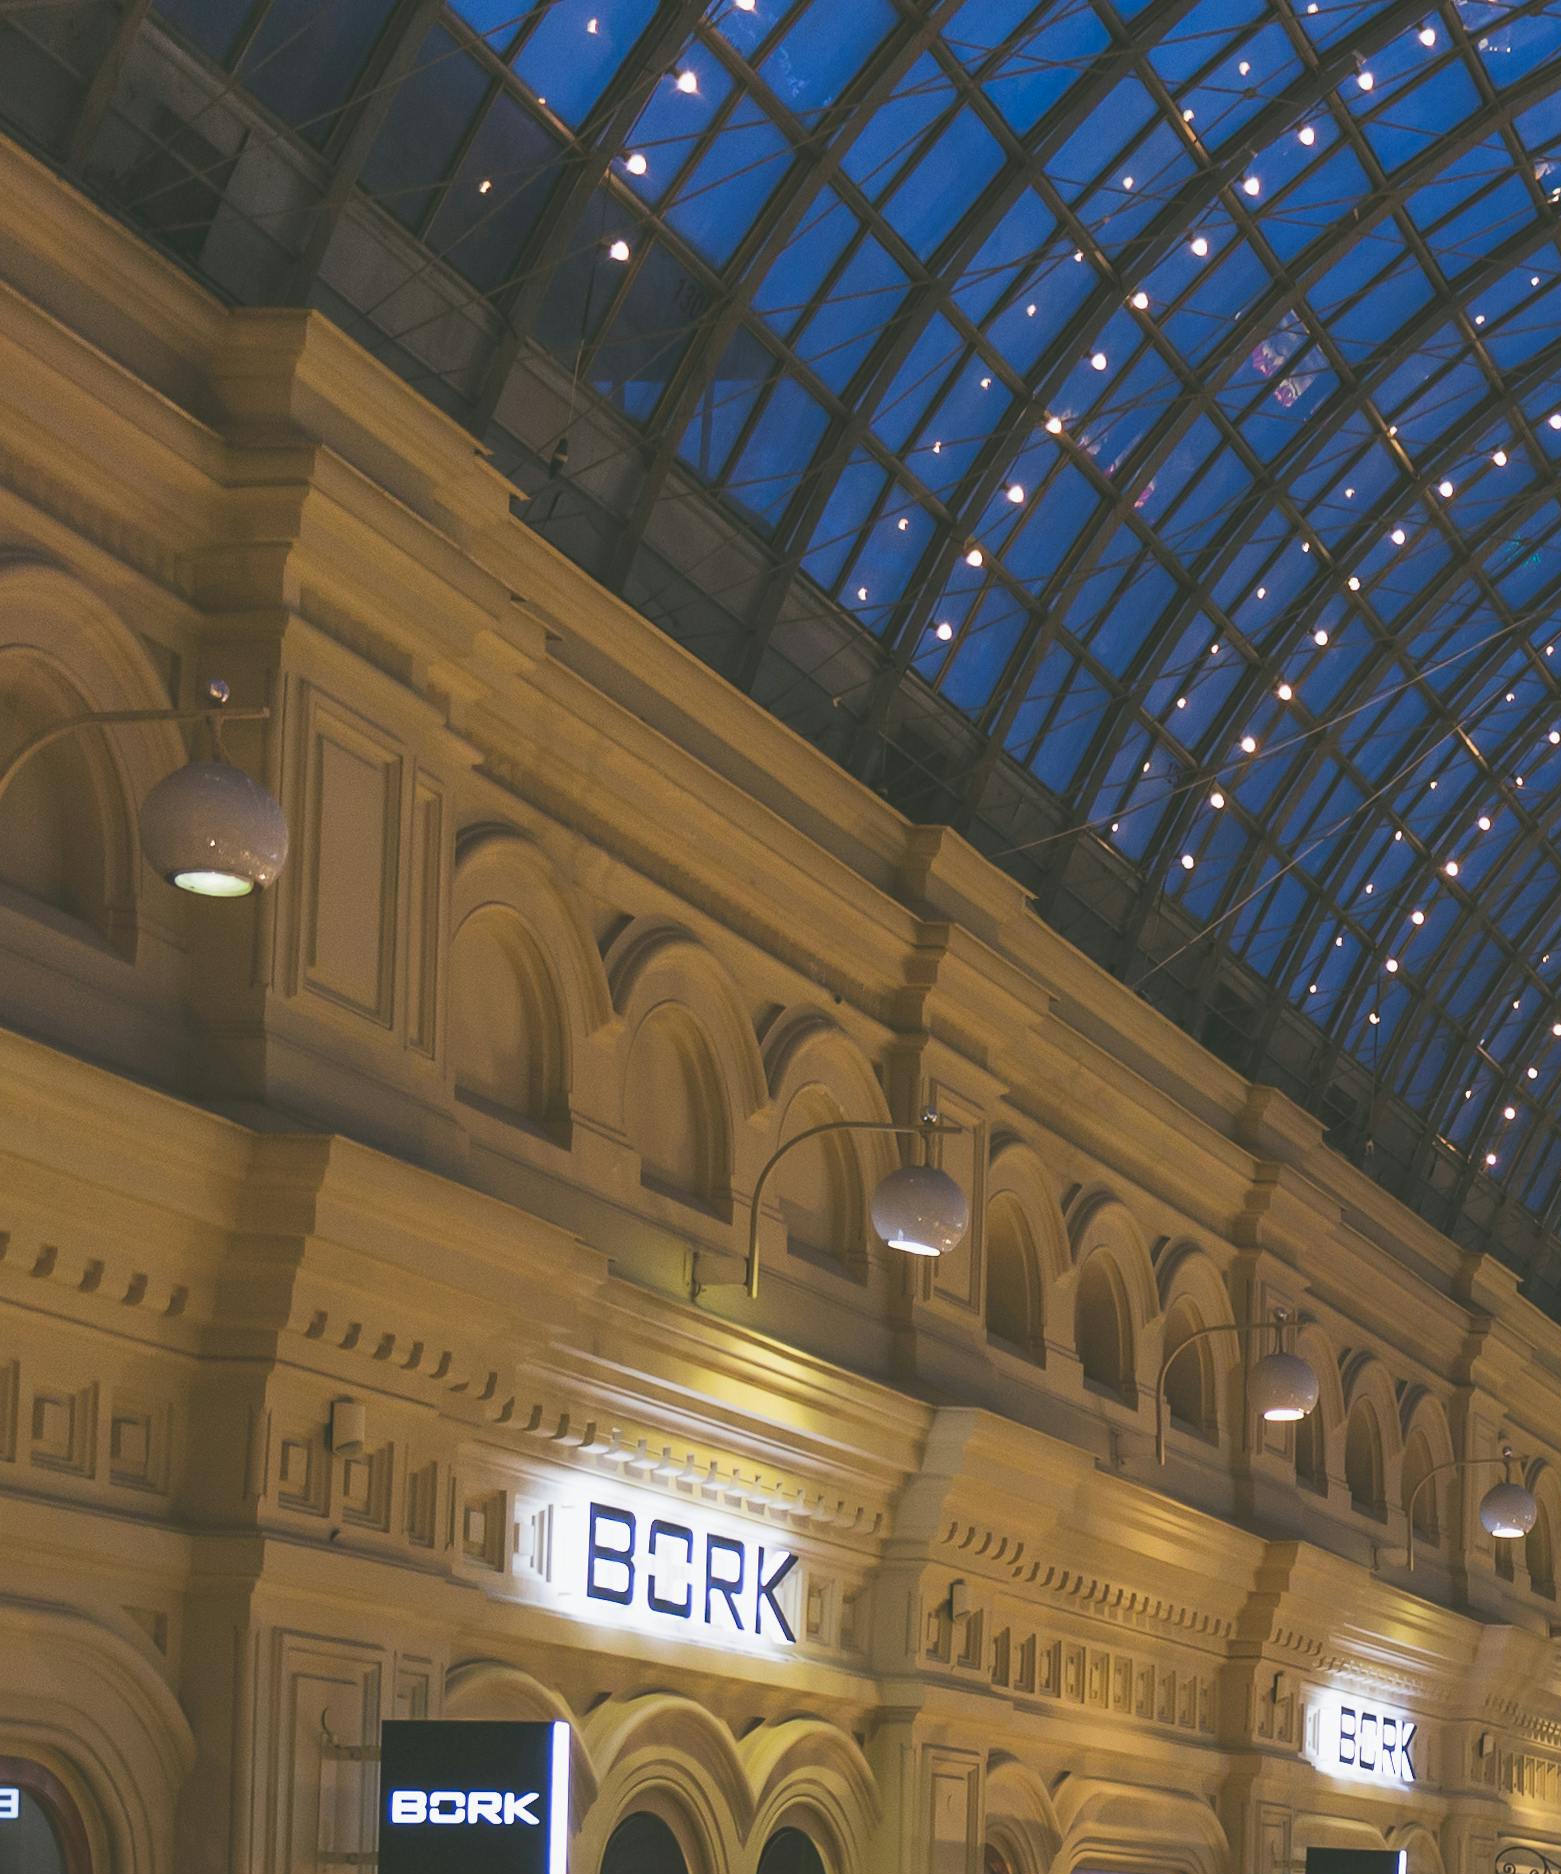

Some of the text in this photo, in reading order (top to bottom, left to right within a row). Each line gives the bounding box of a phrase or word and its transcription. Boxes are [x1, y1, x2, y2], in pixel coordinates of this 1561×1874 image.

[586, 1501, 799, 1644] BORK
[1339, 1705, 1418, 1782] BORK
[391, 1790, 541, 1826] BORK
